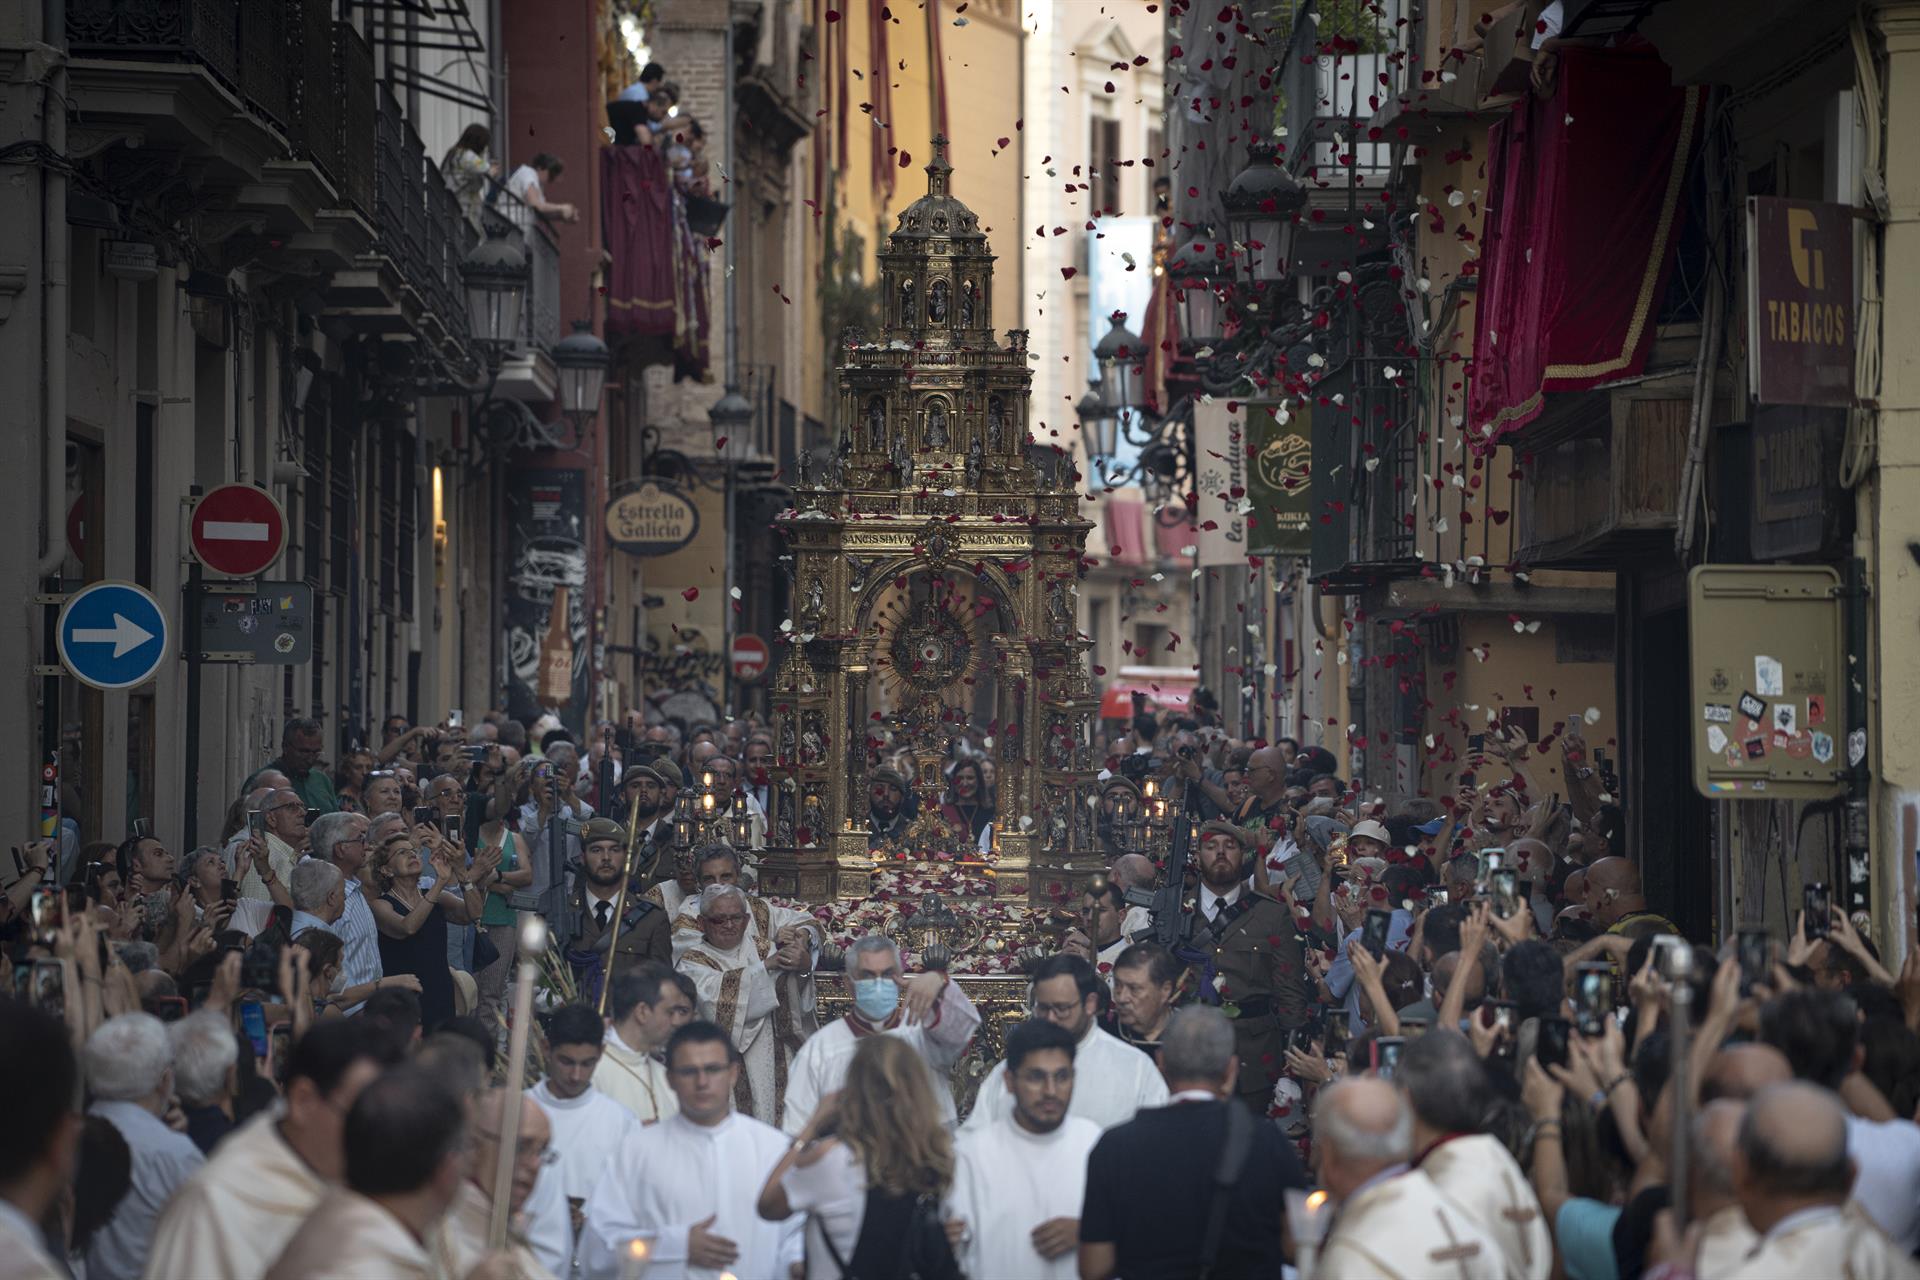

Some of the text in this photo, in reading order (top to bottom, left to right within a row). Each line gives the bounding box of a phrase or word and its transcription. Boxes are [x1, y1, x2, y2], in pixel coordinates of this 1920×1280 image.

[1768, 300, 1845, 346] TABACOS
[617, 502, 684, 520] Estrella
[620, 520, 682, 538] Galicia
[1225, 521, 1242, 542] la
